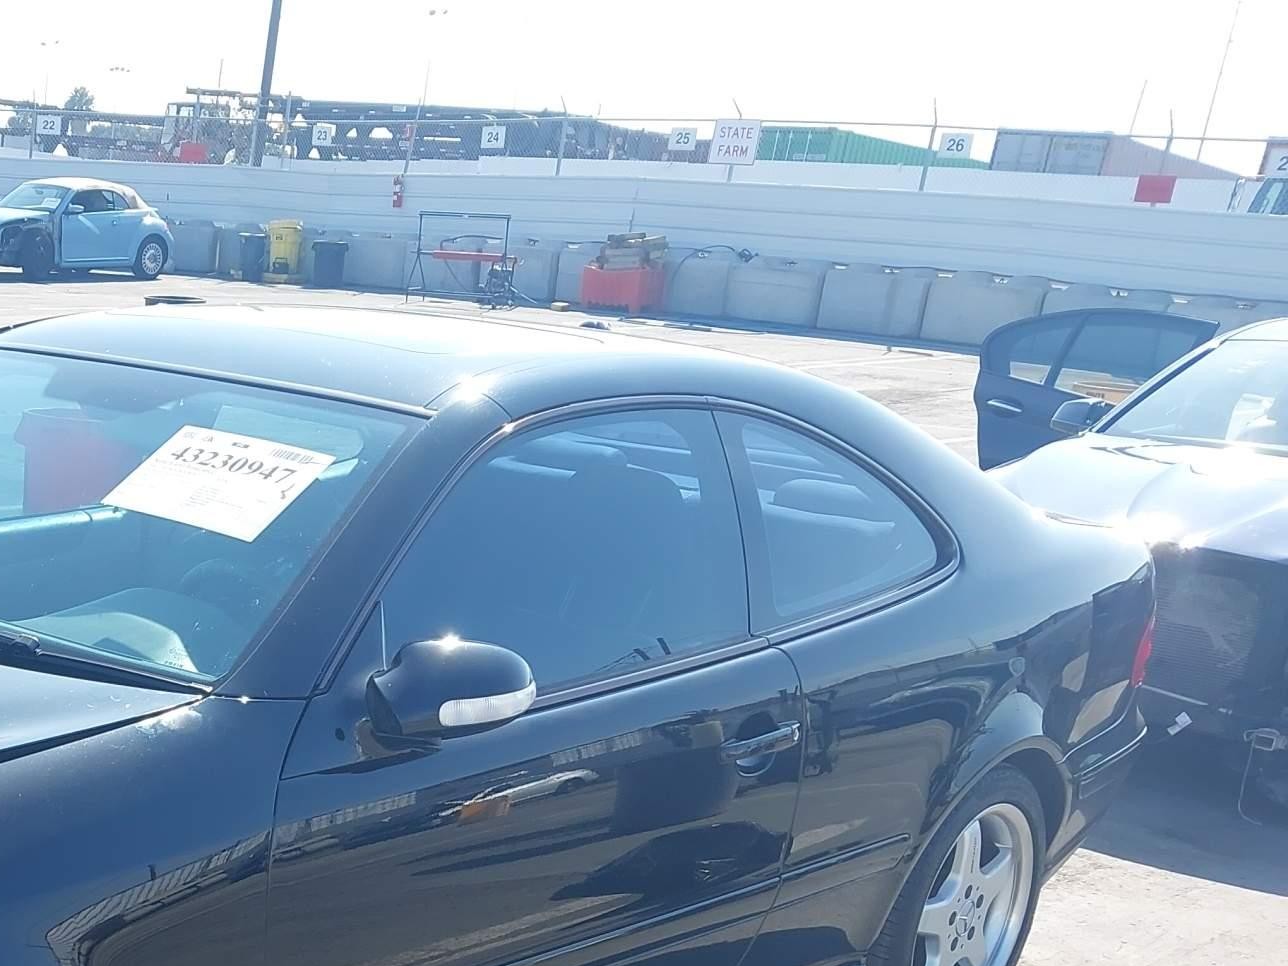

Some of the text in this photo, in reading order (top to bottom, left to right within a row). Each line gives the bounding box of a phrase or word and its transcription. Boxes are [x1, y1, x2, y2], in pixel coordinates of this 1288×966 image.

[42, 119, 55, 130] 22
[317, 129, 328, 141] 23
[487, 132, 499, 143] 24
[675, 132, 690, 144] 25
[719, 126, 754, 140] STATE
[717, 145, 749, 158] FARM
[946, 138, 965, 152] 26
[1277, 156, 1288, 171] 2
[170, 446, 298, 484] 43230947
